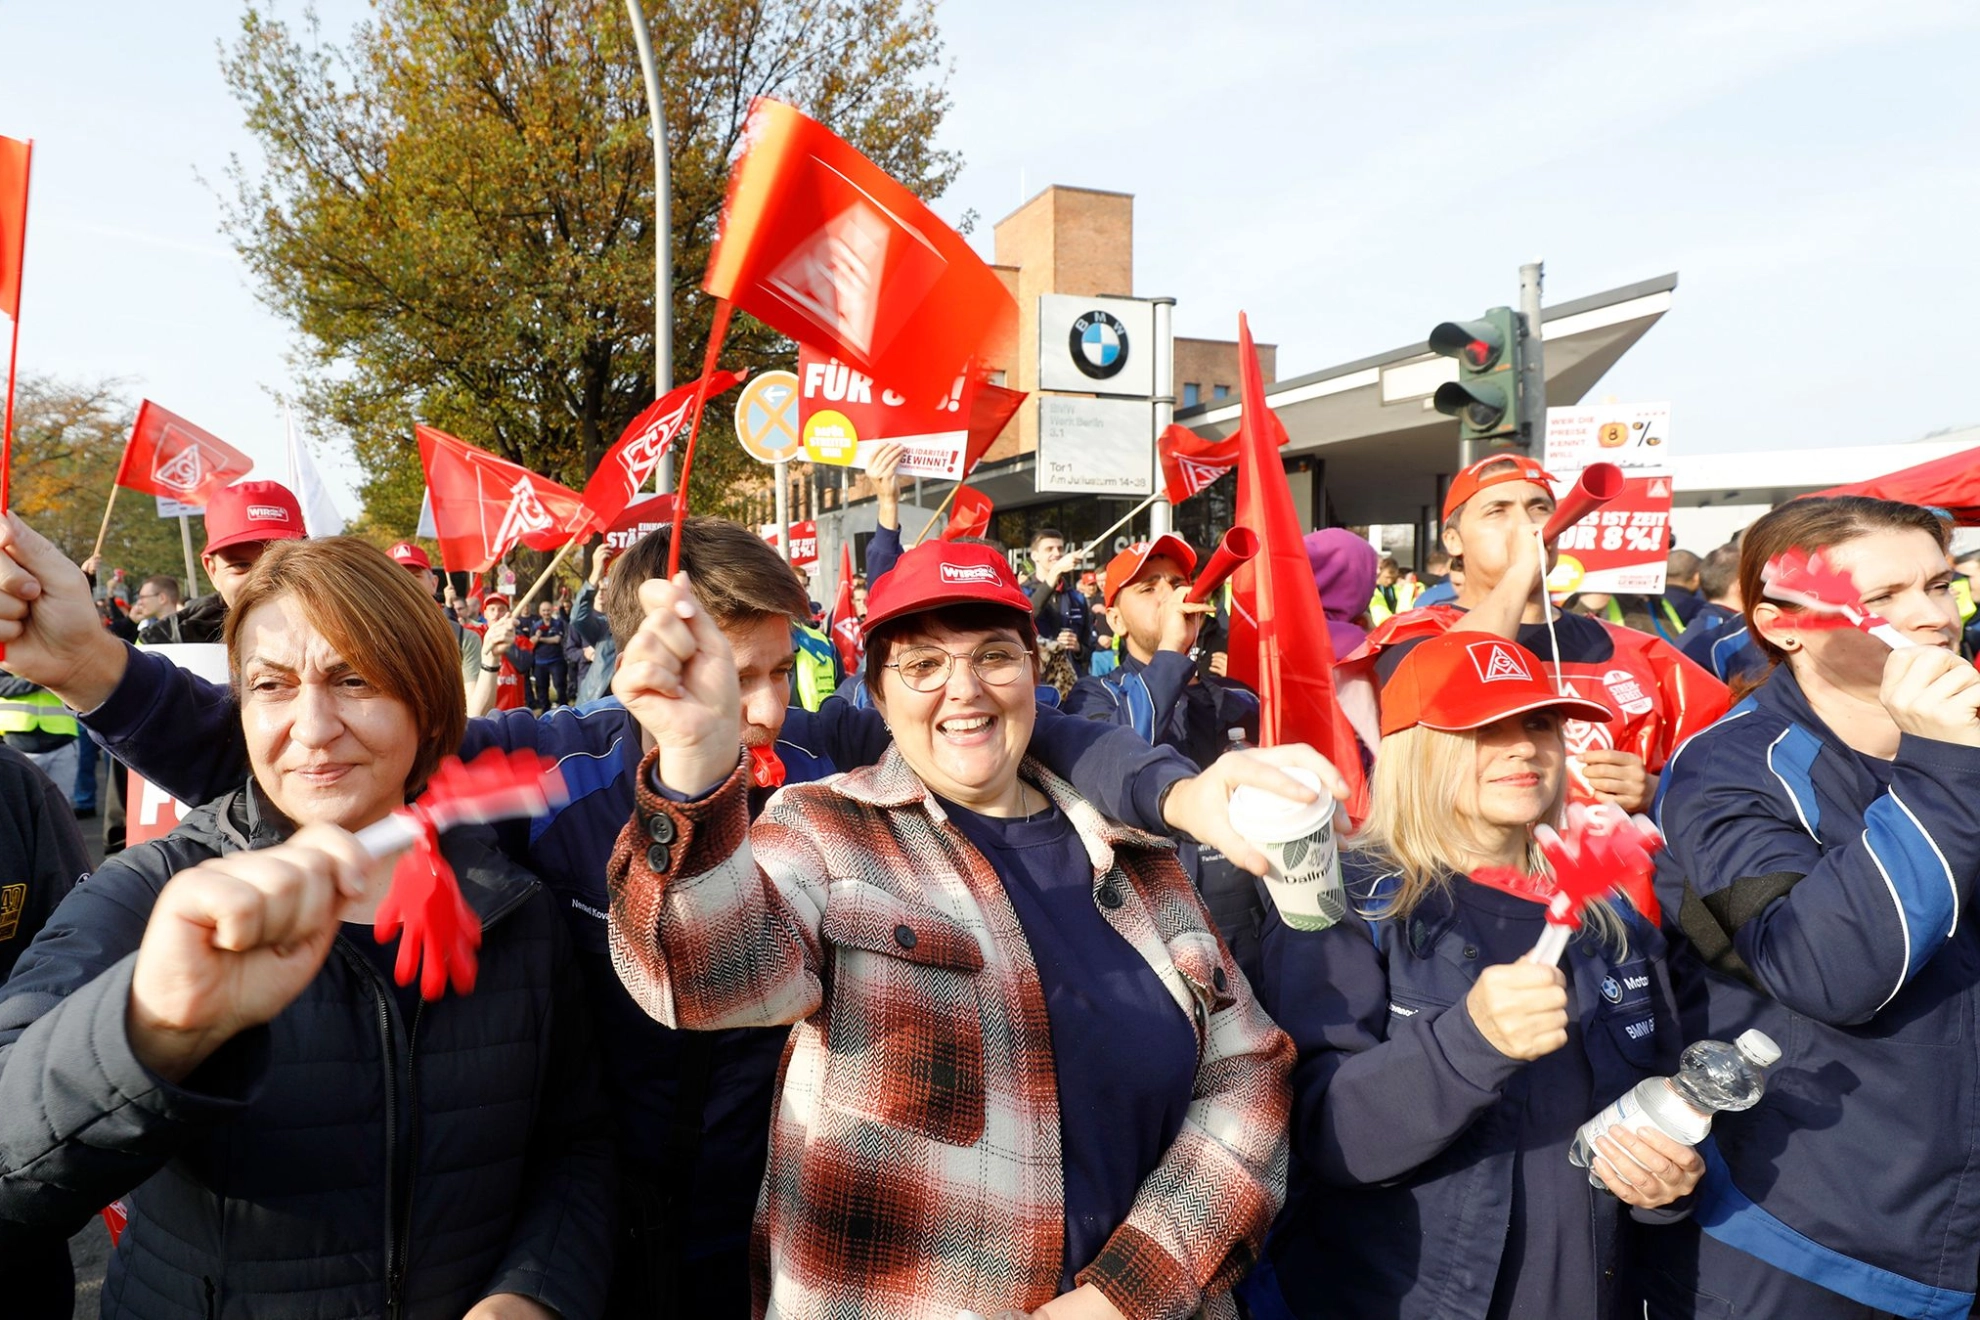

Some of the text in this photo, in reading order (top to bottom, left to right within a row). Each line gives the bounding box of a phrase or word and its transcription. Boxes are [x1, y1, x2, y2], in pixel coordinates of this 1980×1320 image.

[1075, 311, 1125, 335] BMW
[1050, 428, 1065, 438] 3.1
[1050, 462, 1073, 472] Tor 1
[1601, 511, 1631, 526] IST
[1630, 511, 1669, 526] ZEIT
[1601, 526, 1664, 551] 8%!
[1625, 1021, 1649, 1040] BMW
